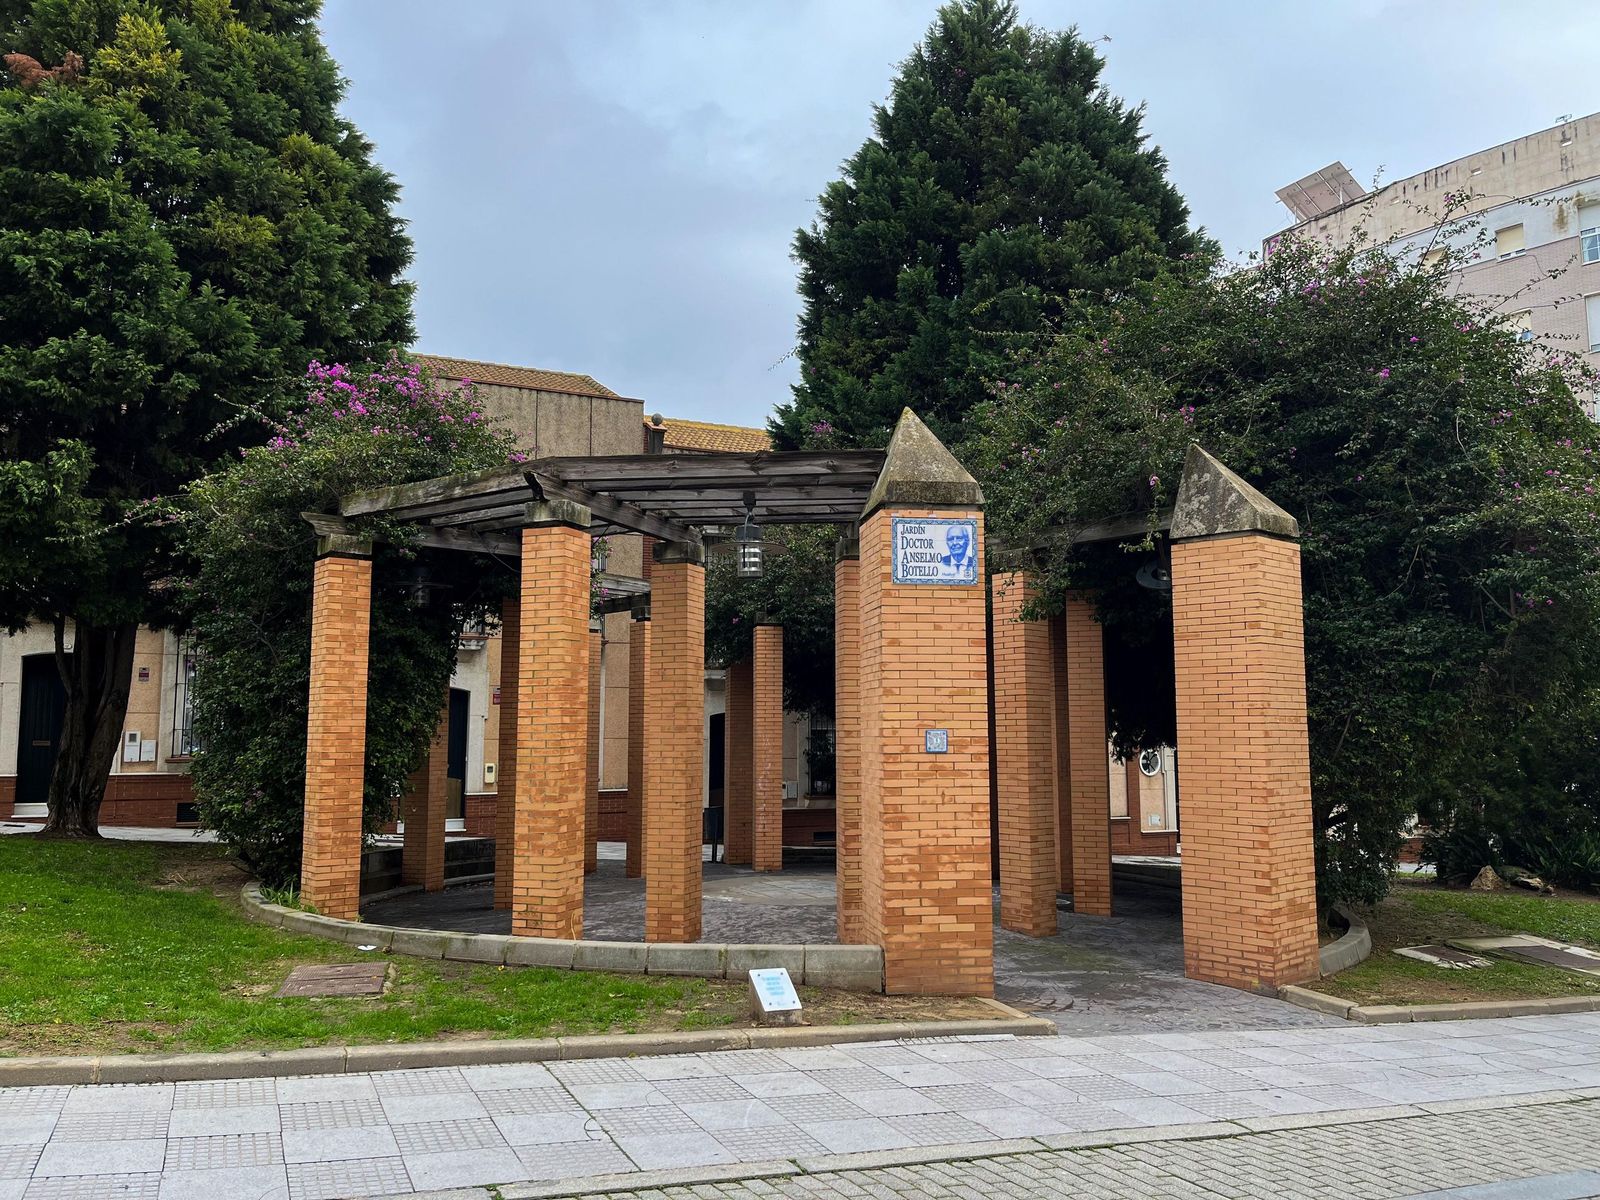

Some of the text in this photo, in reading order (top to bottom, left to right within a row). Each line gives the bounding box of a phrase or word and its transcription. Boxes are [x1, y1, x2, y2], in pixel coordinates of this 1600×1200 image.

[901, 524, 925, 535] JARDÍN
[901, 536, 934, 549] DOCTOR
[901, 550, 942, 563] ANSELMO
[902, 564, 938, 577] BOTELLO
